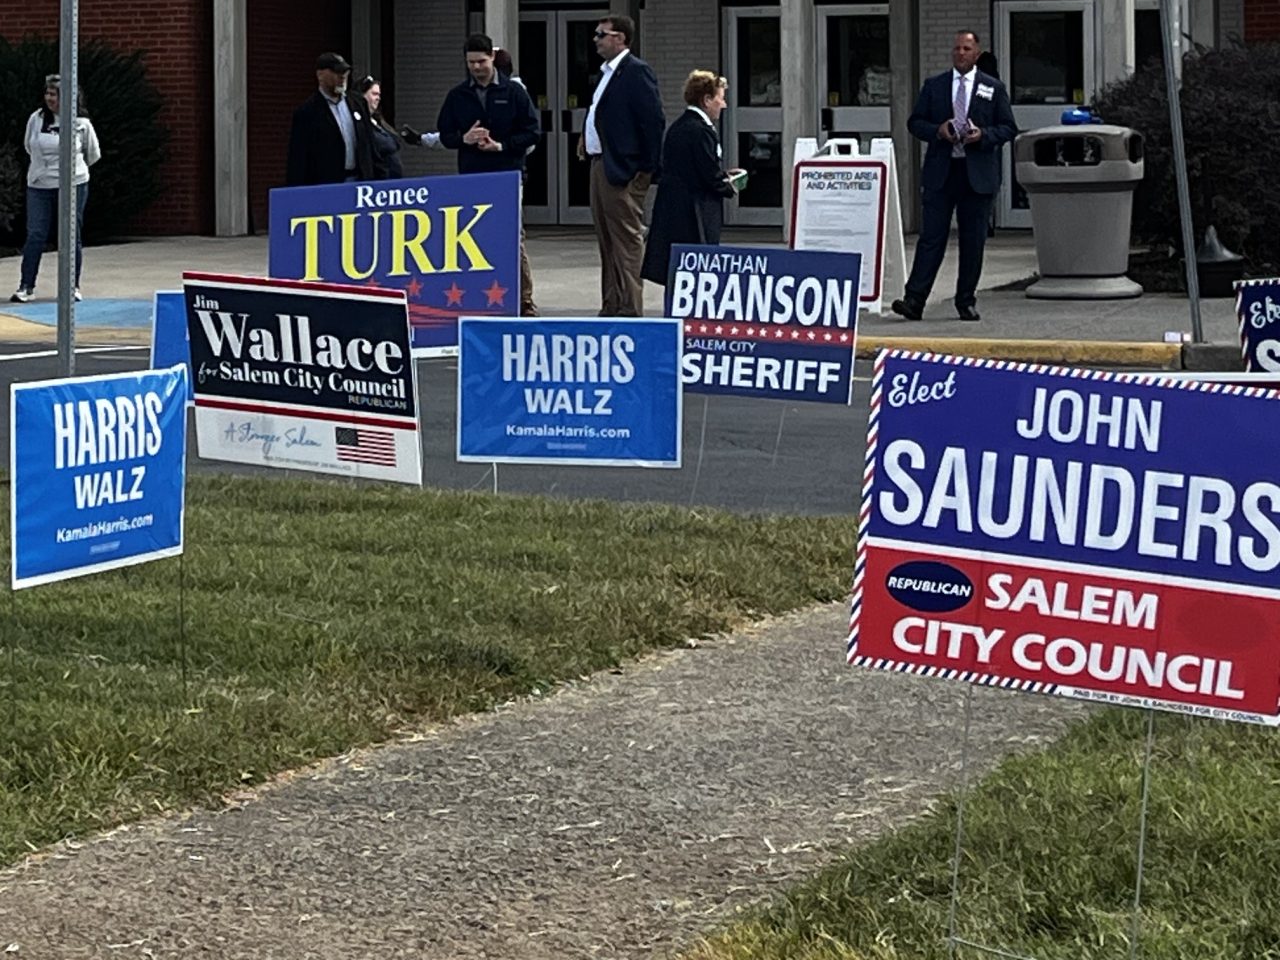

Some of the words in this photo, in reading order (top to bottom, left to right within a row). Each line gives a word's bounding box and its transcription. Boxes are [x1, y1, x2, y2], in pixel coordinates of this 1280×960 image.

[801, 171, 853, 181] PROHIBITED
[854, 172, 878, 181] AREA
[806, 181, 825, 190] AND
[826, 181, 872, 190] ACTIVITIES
[355, 185, 429, 208] Renee
[290, 204, 495, 281] TURK
[677, 252, 768, 274] JONATHAN
[193, 295, 219, 310] Jim
[671, 271, 852, 328] BRANSON
[194, 310, 404, 374] Wallace
[502, 334, 635, 384] HARRIS
[686, 338, 726, 351] SALEM
[729, 340, 757, 352] CITY
[198, 362, 218, 385] for
[220, 361, 280, 385] Salem
[283, 367, 324, 395] City
[328, 372, 406, 399] Council
[682, 352, 841, 393] SHERIFF
[887, 371, 957, 408] Elect
[348, 394, 407, 410] REPUBLICAN
[524, 389, 613, 415] WALZ
[1016, 387, 1163, 453] JOHN
[53, 391, 163, 469] HARRIS
[284, 425, 322, 449] Salem
[506, 424, 631, 439] KamalaHarris.com
[74, 466, 146, 510] WALZ
[879, 439, 1280, 572] SAUNDERS
[56, 514, 153, 543] KamalaHarris.com
[887, 575, 972, 598] REPUBLICAN
[984, 572, 1158, 630] SALEM
[892, 616, 1006, 663] CITY
[1012, 633, 1245, 701] COUNCIL
[1073, 689, 1090, 698] PAID
[1195, 707, 1211, 715] FOR
[1212, 708, 1230, 718] CITY
